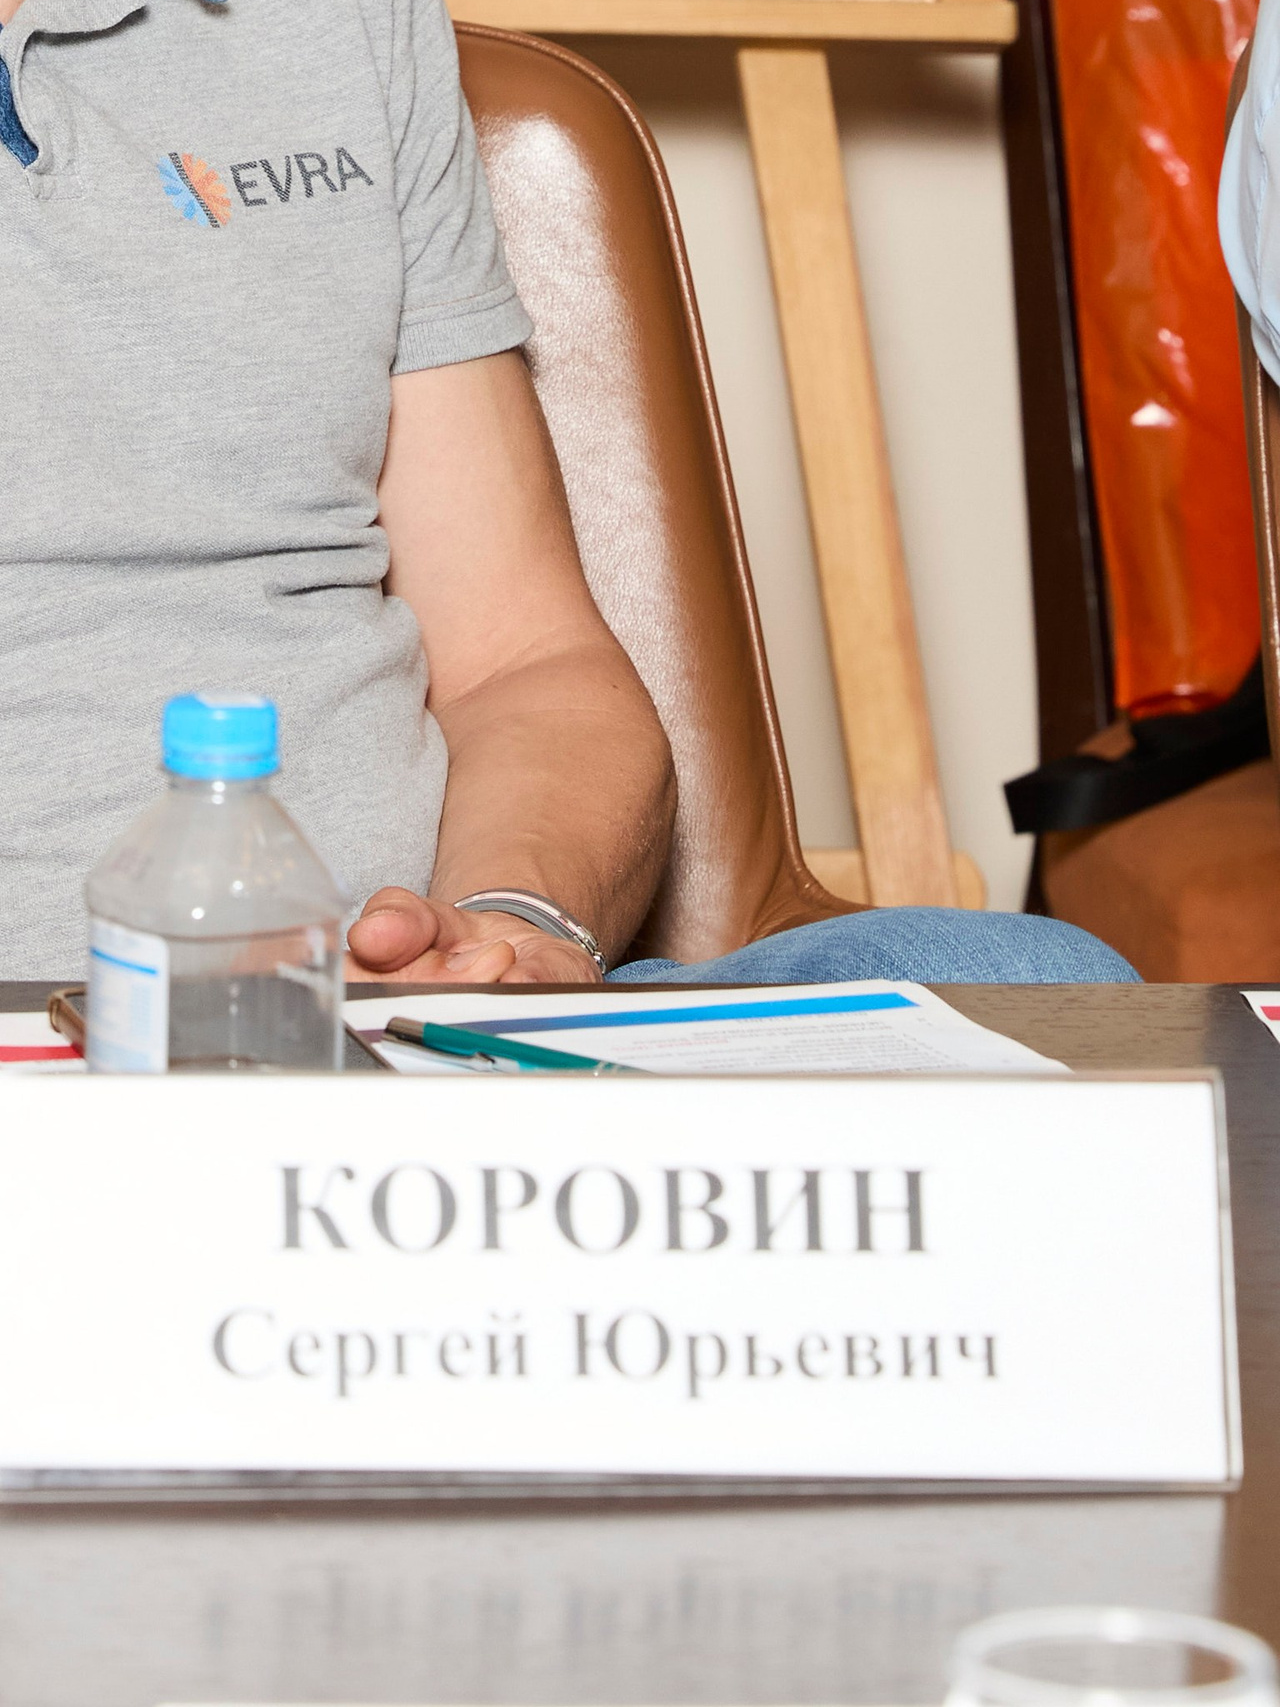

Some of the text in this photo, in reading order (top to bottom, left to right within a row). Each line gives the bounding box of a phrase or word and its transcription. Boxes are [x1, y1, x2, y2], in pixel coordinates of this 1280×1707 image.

[229, 146, 375, 207] EVRA
[280, 1164, 928, 1253] КОРОВИН
[211, 1307, 1000, 1398] Сергей Юрьевич
